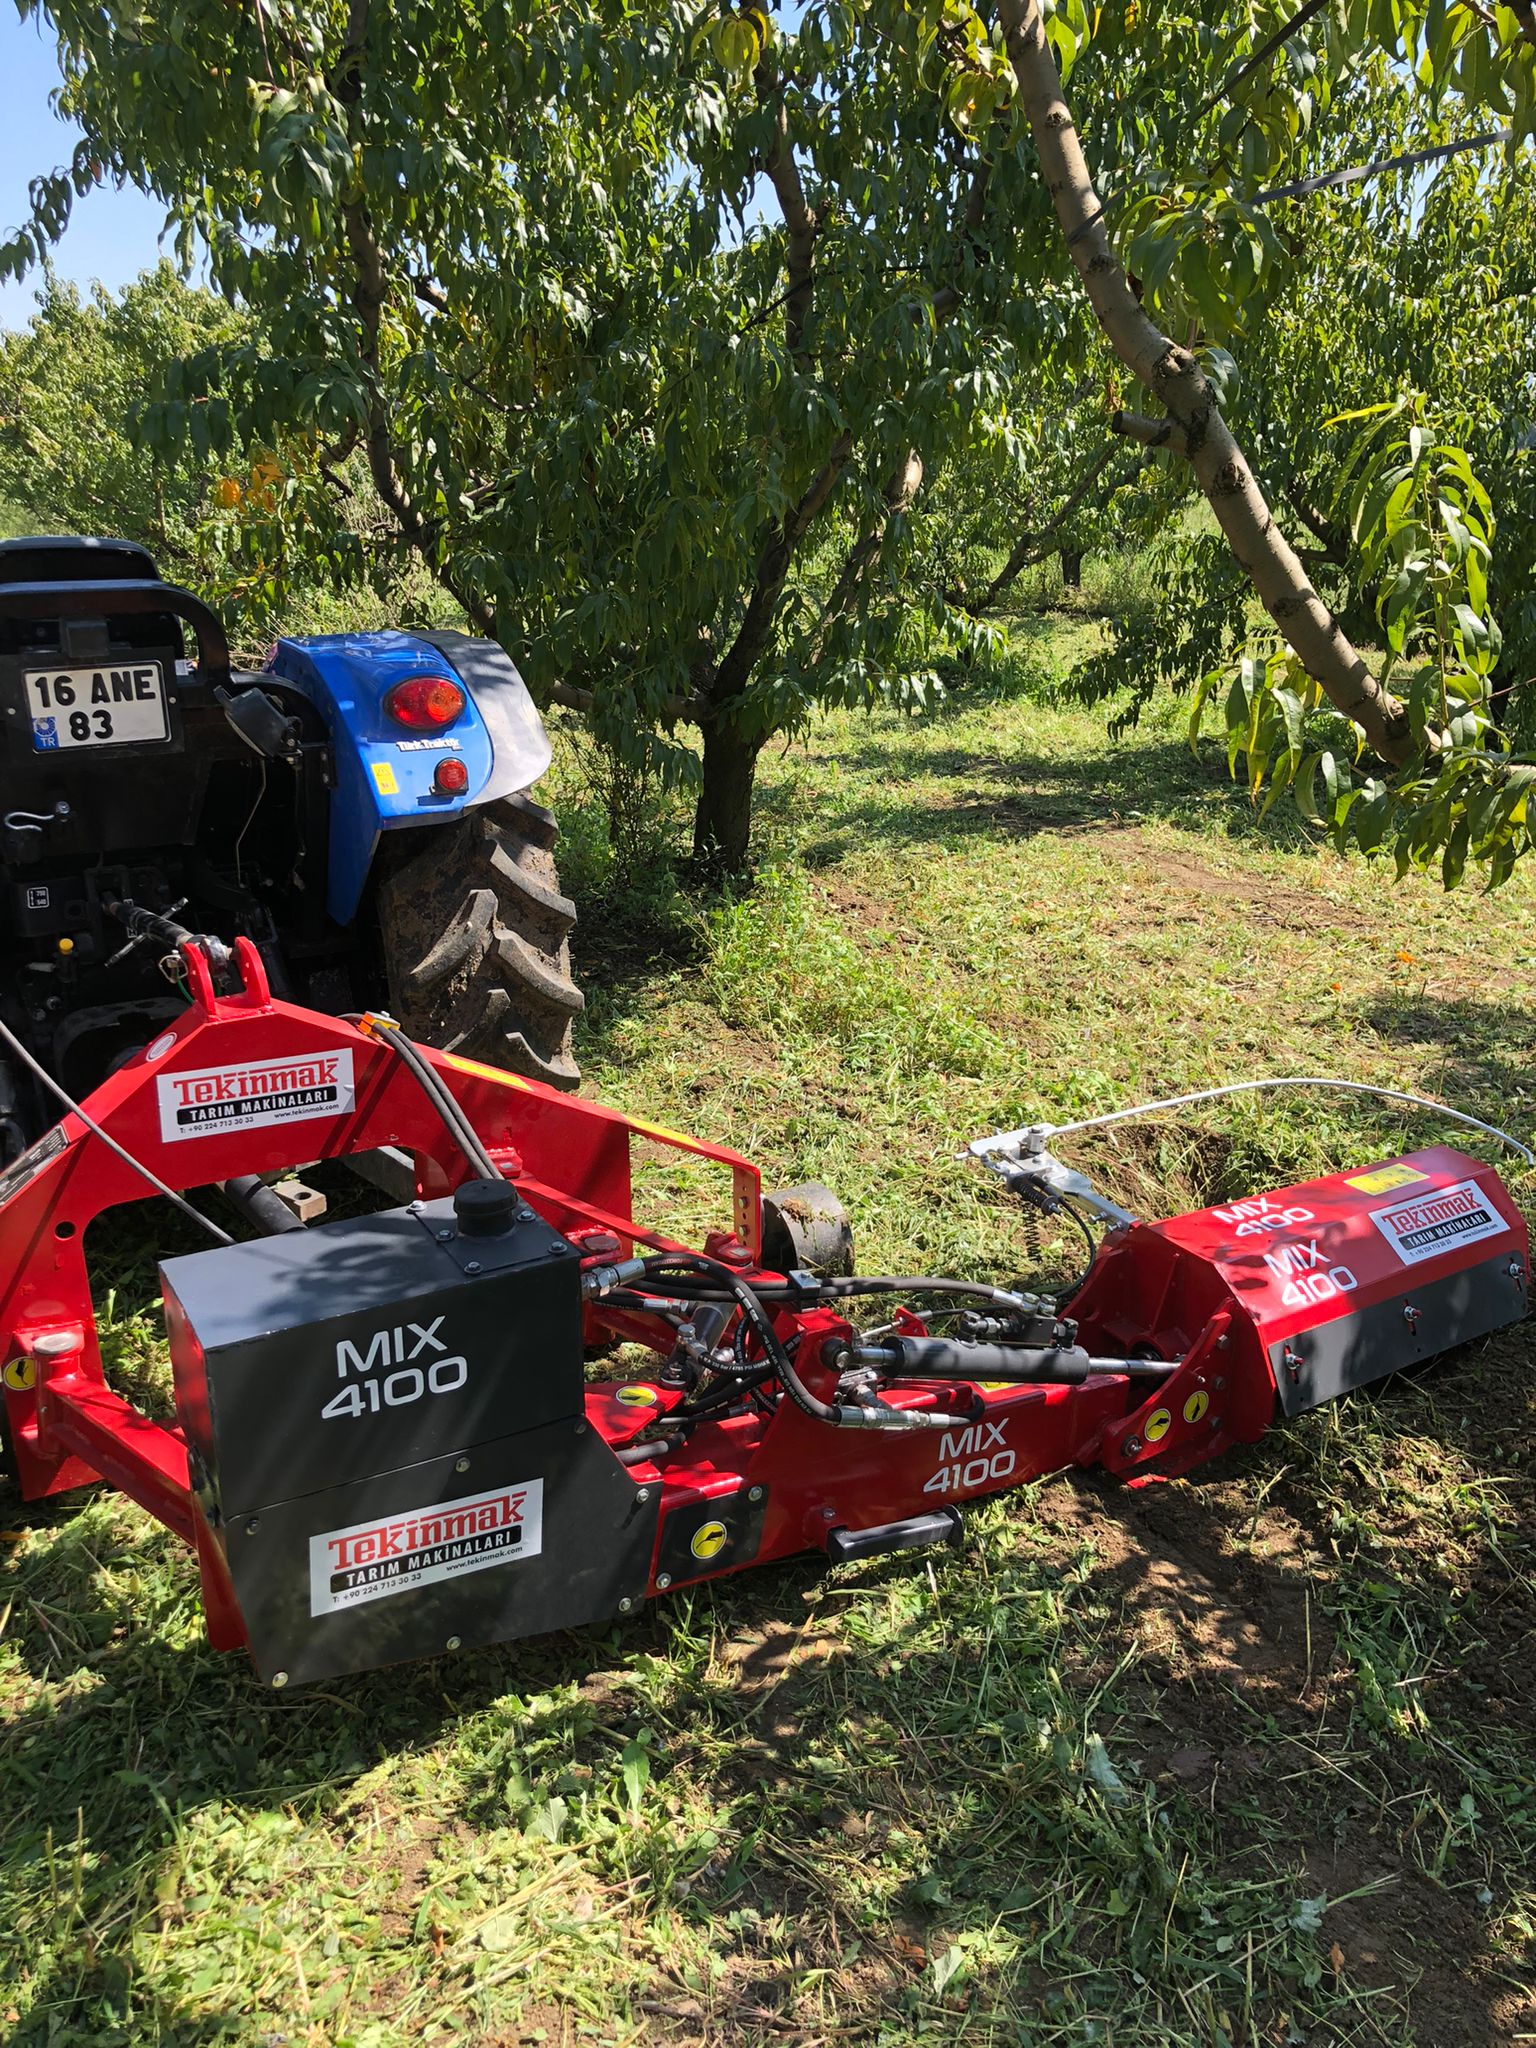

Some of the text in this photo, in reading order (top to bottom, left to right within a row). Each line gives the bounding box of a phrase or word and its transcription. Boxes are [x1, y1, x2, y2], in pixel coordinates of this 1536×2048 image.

[35, 669, 156, 708] 16 ANE
[40, 737, 56, 747] TR
[69, 709, 114, 741] 83
[173, 1057, 339, 1106] Tekinmak
[188, 1124, 203, 1132] +90
[204, 1121, 218, 1130] 224
[219, 1119, 233, 1127] 713
[234, 1117, 243, 1125] 30
[245, 1116, 254, 1124] 33
[274, 1103, 339, 1119] www.tekinmak.com
[190, 1090, 328, 1122] TARIM MAKİNALARI
[1212, 1197, 1283, 1224] MIX
[1235, 1207, 1315, 1237] 4100
[1381, 1188, 1482, 1235] Tekinmak
[1407, 1212, 1487, 1247] TARIM MAKİNALARI
[1263, 1239, 1331, 1278] MIX
[1282, 1265, 1358, 1306] 4100
[336, 1315, 448, 1378] MIX
[321, 1356, 468, 1420] 4100
[939, 1417, 1009, 1462] MIX
[923, 1449, 1016, 1493] 4100
[328, 1491, 527, 1570] Tekinmak
[343, 1589, 360, 1600] +90
[362, 1585, 379, 1595] 224
[381, 1580, 396, 1590] 713
[398, 1577, 409, 1586] 30
[411, 1573, 422, 1582] 33
[446, 1545, 523, 1572] www.tekinmak.com
[346, 1531, 511, 1587] TARIM MAKİNALARI
